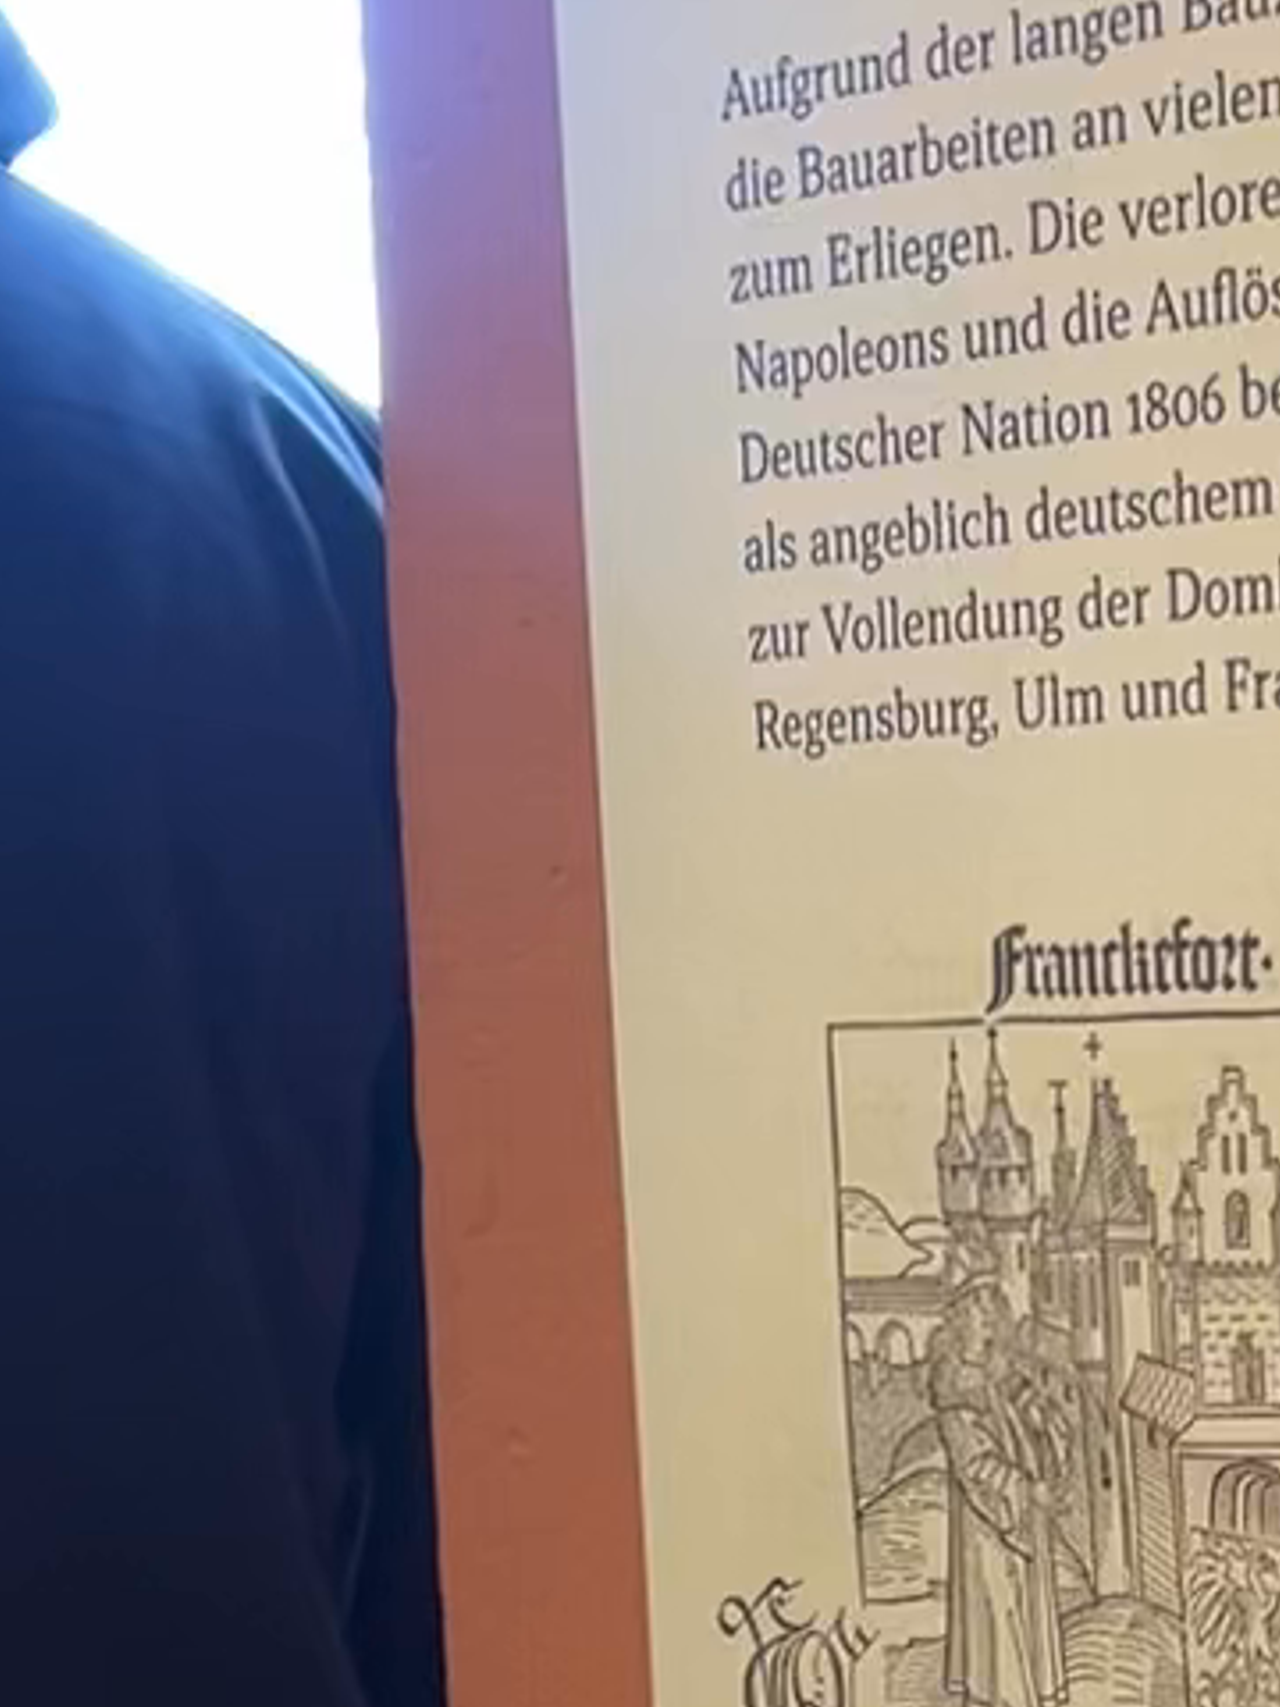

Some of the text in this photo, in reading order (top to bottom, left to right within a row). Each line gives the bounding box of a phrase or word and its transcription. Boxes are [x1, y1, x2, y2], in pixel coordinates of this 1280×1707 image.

[726, 157, 785, 212] die
[797, 116, 1057, 200] Bauarbeiten
[1072, 103, 1127, 151] an
[735, 325, 950, 400] Napoleons
[963, 294, 1048, 361] und
[1062, 287, 1131, 347] die
[744, 518, 798, 574] als
[809, 491, 1011, 576] angeblich
[1025, 468, 1274, 542] deutschem
[754, 685, 999, 760] Regensburg,
[1013, 671, 1105, 730] Ulm
[1121, 659, 1208, 722] und
